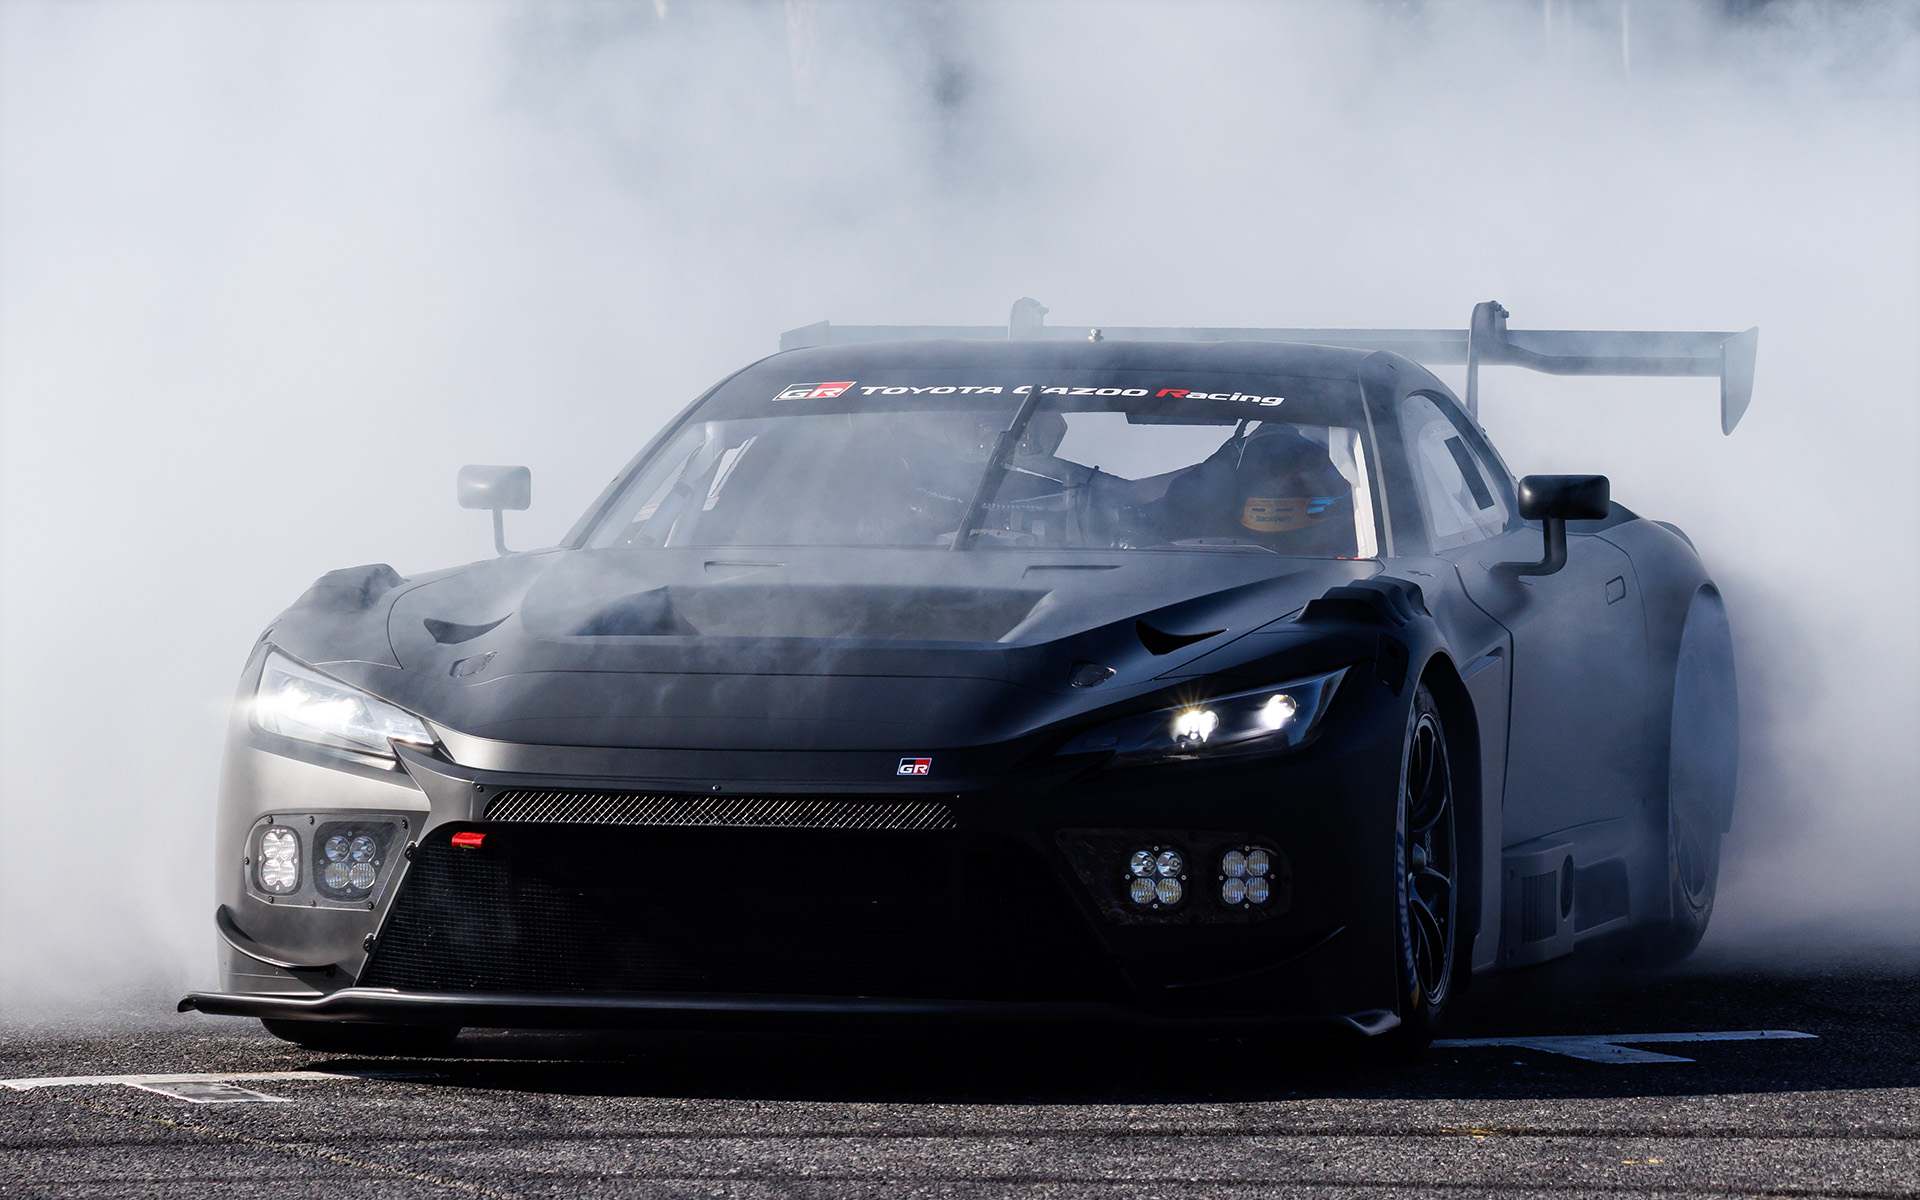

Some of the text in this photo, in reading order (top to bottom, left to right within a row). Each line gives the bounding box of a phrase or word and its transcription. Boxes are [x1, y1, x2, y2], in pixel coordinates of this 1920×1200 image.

[777, 385, 1286, 407] GR TOYOTA GAZOO Racing
[898, 762, 930, 774] GR
[1396, 844, 1414, 970] MICHELIN
